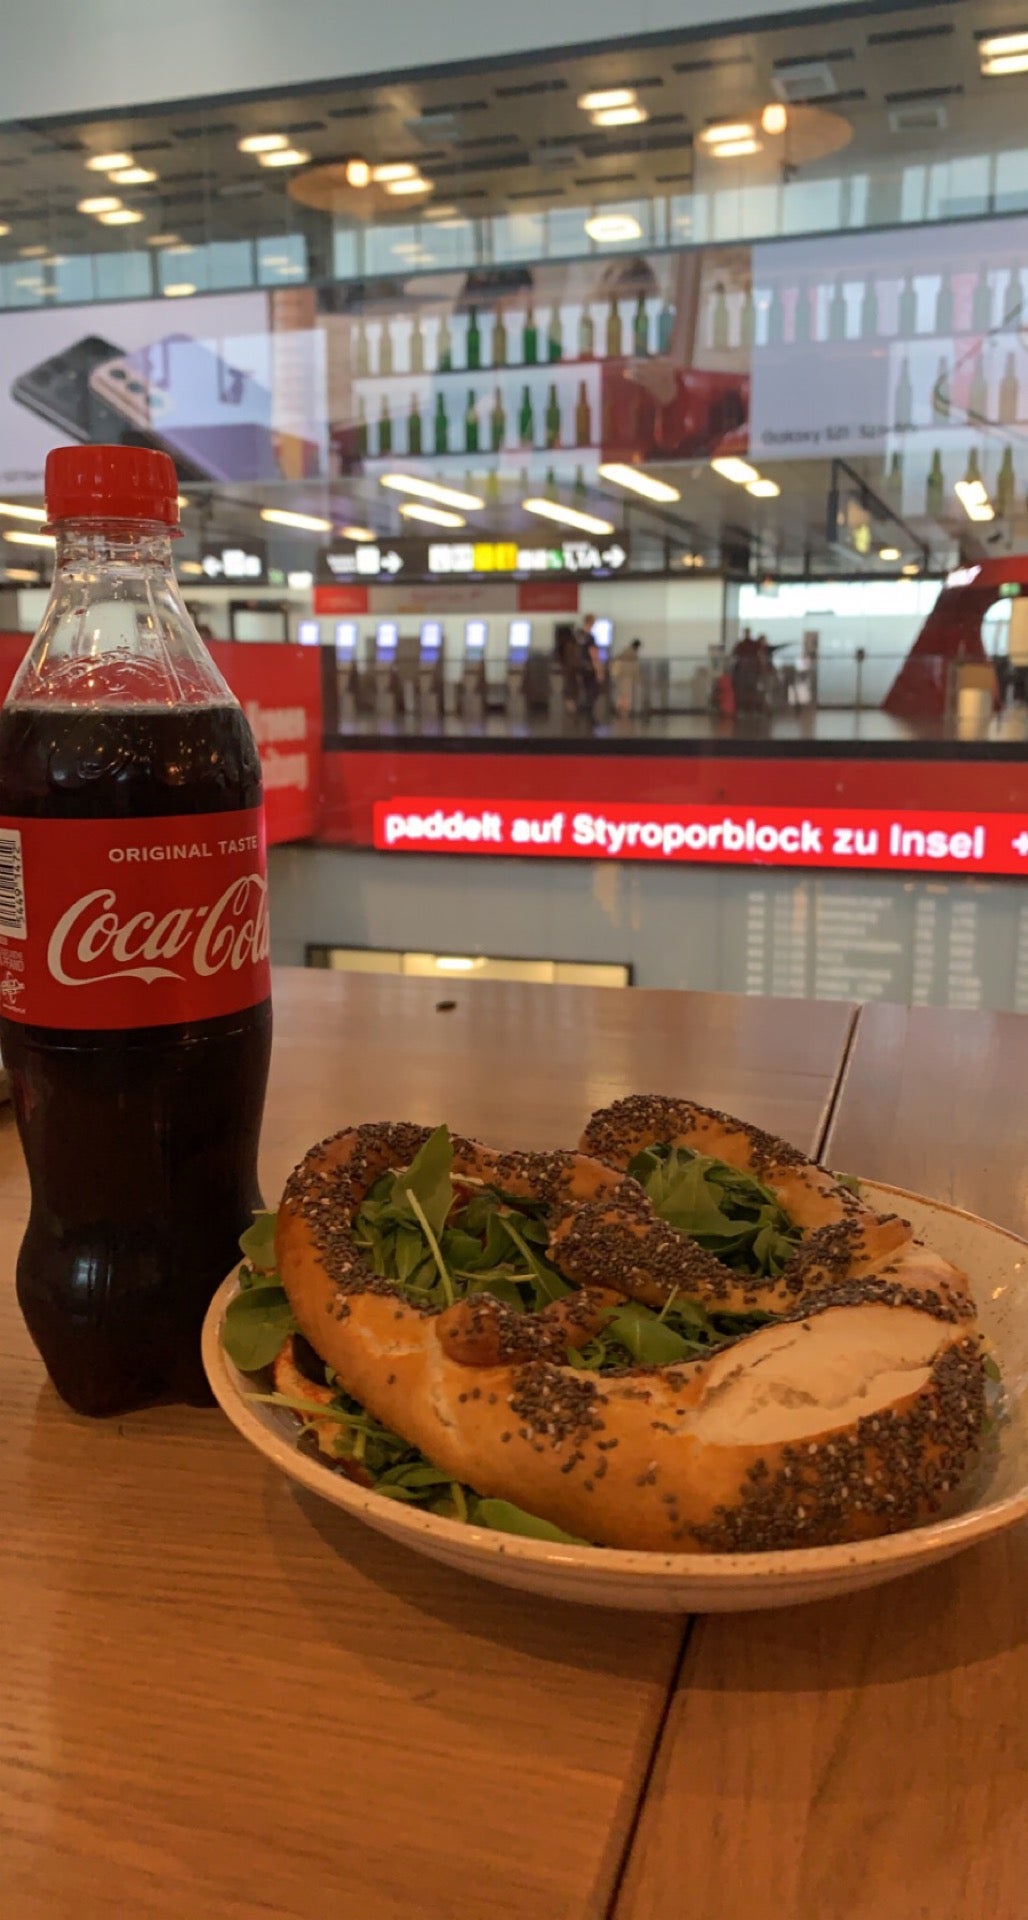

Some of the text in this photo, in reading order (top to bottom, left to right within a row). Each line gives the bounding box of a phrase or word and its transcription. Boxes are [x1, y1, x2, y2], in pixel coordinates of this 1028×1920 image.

[108, 835, 258, 863] ORIGINAL TASTE
[385, 811, 502, 843] paddelt
[511, 812, 564, 844] auf
[572, 812, 822, 855] Styroporblock
[832, 828, 878, 855] zu
[890, 824, 985, 859] Insel
[47, 873, 269, 986] Coca-Cola
